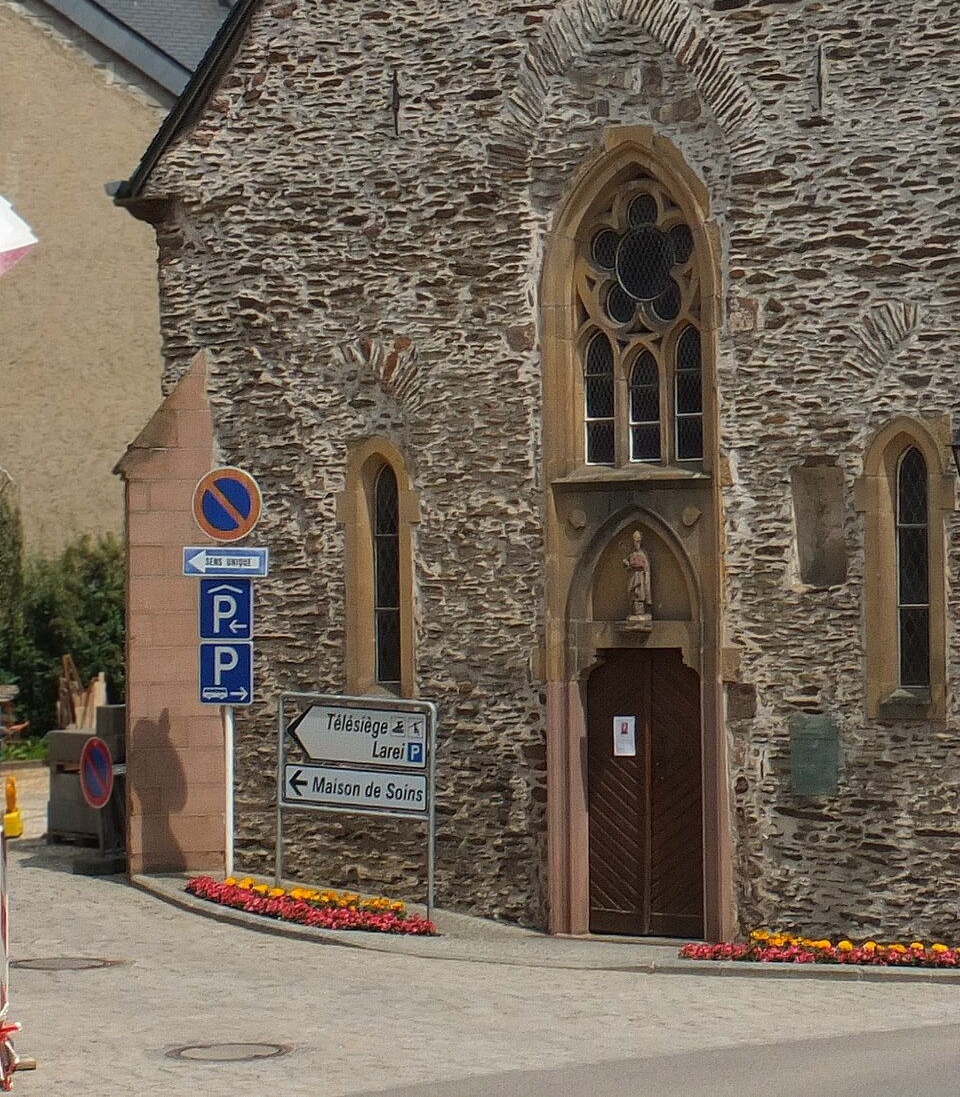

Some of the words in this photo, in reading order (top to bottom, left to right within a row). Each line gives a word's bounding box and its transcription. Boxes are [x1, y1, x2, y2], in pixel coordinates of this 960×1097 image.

[205, 557, 223, 566] SENS
[226, 558, 252, 568] UNIQUE
[213, 594, 237, 634] P
[214, 646, 239, 686] P
[326, 712, 388, 739] Télésiège
[372, 740, 406, 760] Larei
[410, 744, 421, 760] P
[312, 776, 361, 797] Maison
[364, 781, 382, 799] de
[385, 782, 424, 802] Soins
